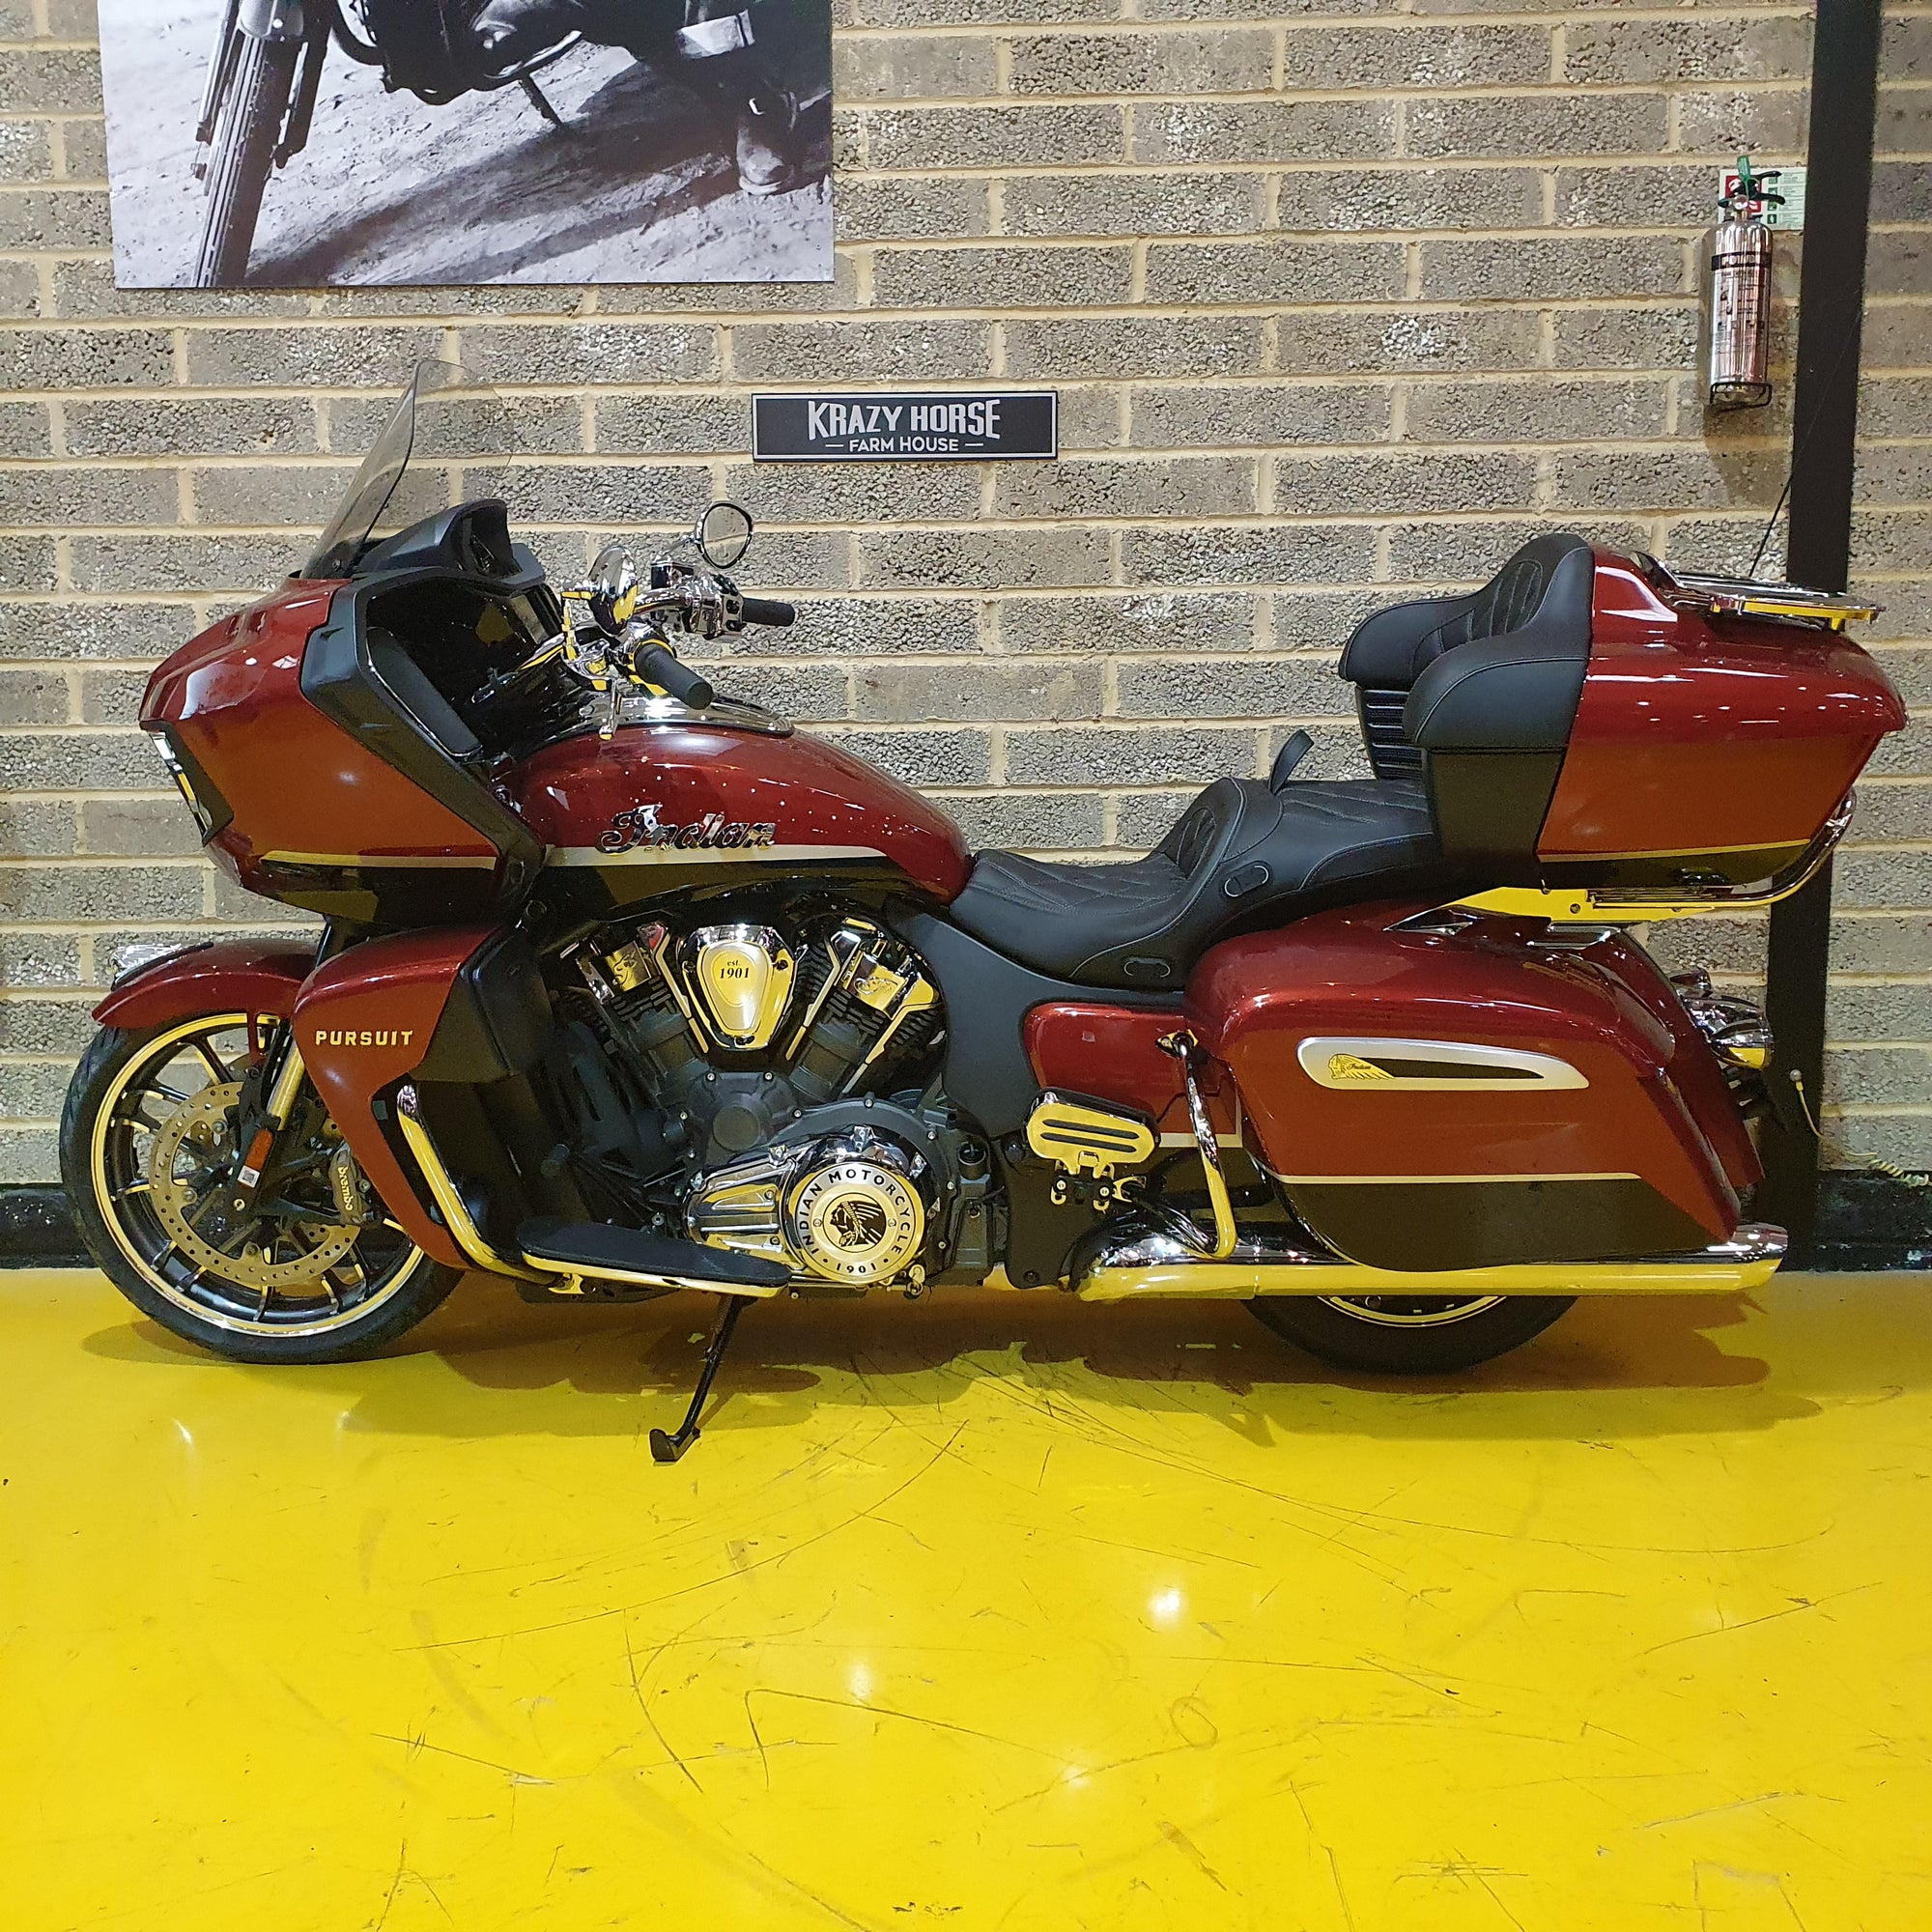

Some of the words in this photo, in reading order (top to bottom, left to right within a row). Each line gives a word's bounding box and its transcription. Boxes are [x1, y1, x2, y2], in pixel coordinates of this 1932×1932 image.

[808, 400, 903, 440] KRAZY
[910, 399, 1001, 440] HORSE
[849, 438, 895, 452] FARM
[899, 437, 959, 452] HOUSE
[595, 803, 777, 856] Indian
[720, 967, 750, 980] 1901
[315, 1030, 413, 1046] PURSUIT
[338, 1165, 354, 1211] brembo
[799, 1182, 823, 1255] INDIAN
[828, 1168, 911, 1254] MOTORCYCLE
[836, 1262, 877, 1274] 1901
